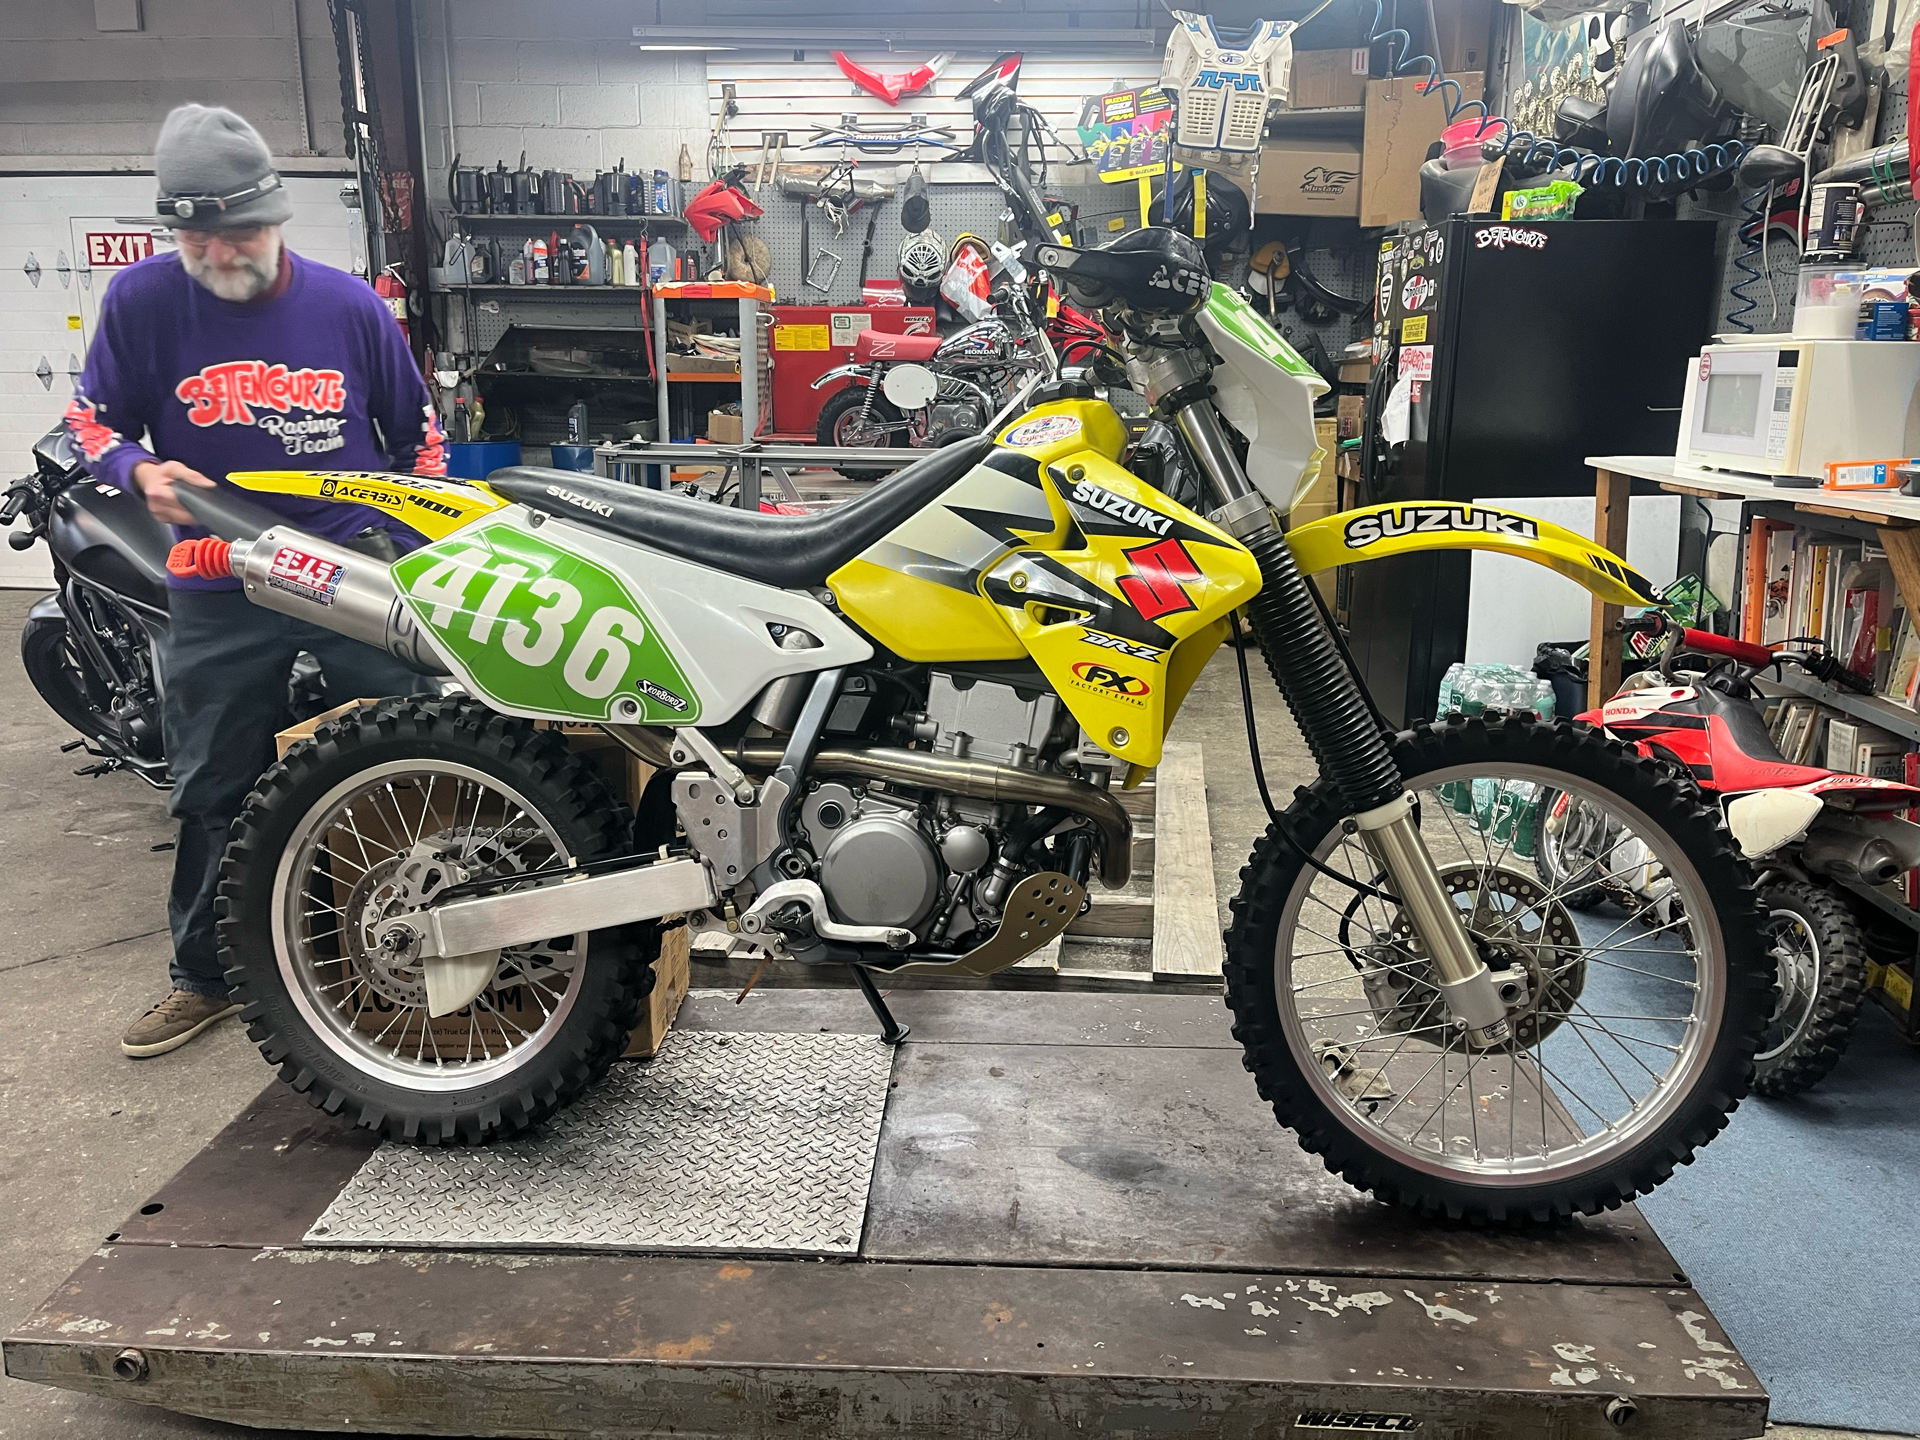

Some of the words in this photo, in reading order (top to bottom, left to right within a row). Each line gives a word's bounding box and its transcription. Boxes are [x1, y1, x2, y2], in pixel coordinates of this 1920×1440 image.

[1302, 184, 1346, 194] Mustang
[88, 235, 148, 264] EXIT
[869, 340, 896, 357] Z
[258, 414, 347, 438] Racing
[282, 434, 346, 456] Team
[407, 495, 463, 518] 400
[546, 484, 615, 518] SUZUKI
[1072, 480, 1174, 536] SUZUKI
[1346, 508, 1537, 548] SUZUKI
[326, 568, 343, 594] USA
[409, 547, 645, 700] 4136
[1081, 630, 1161, 662] DR-Z
[1070, 680, 1109, 696] FACTORY
[1085, 666, 1137, 693] FX
[1605, 707, 1637, 716] HONDA
[1874, 766, 1900, 777] HON
[1555, 794, 1571, 817] DUNLO
